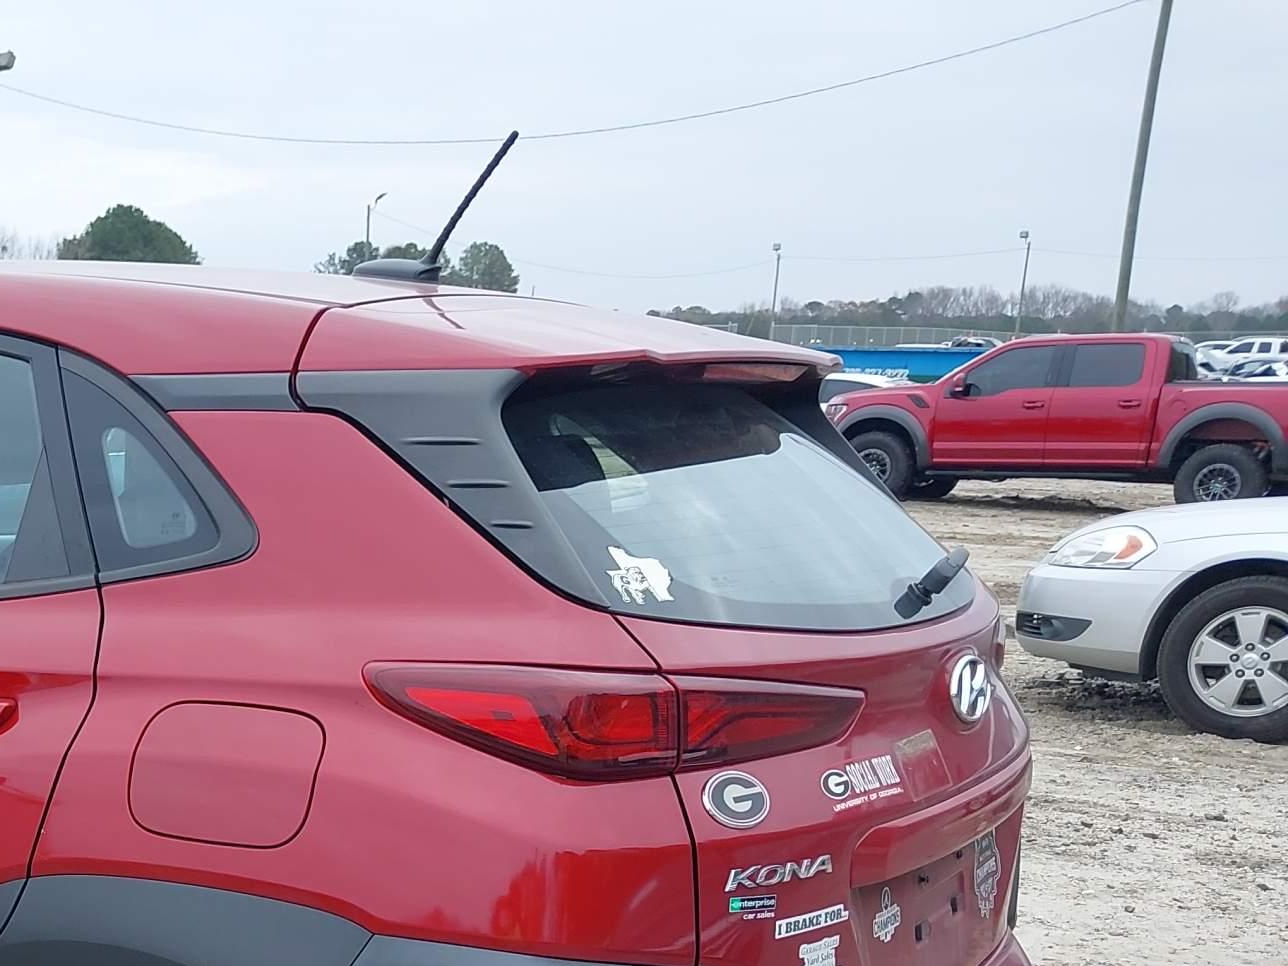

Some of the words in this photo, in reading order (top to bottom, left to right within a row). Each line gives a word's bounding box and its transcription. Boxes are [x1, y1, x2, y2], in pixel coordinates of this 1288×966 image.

[708, 772, 768, 826] G
[869, 792, 878, 801] OF
[724, 854, 833, 892] KONA
[731, 897, 775, 909] enterprise
[756, 910, 775, 918] sales
[777, 923, 784, 936] I
[785, 913, 822, 934] BRAKE
